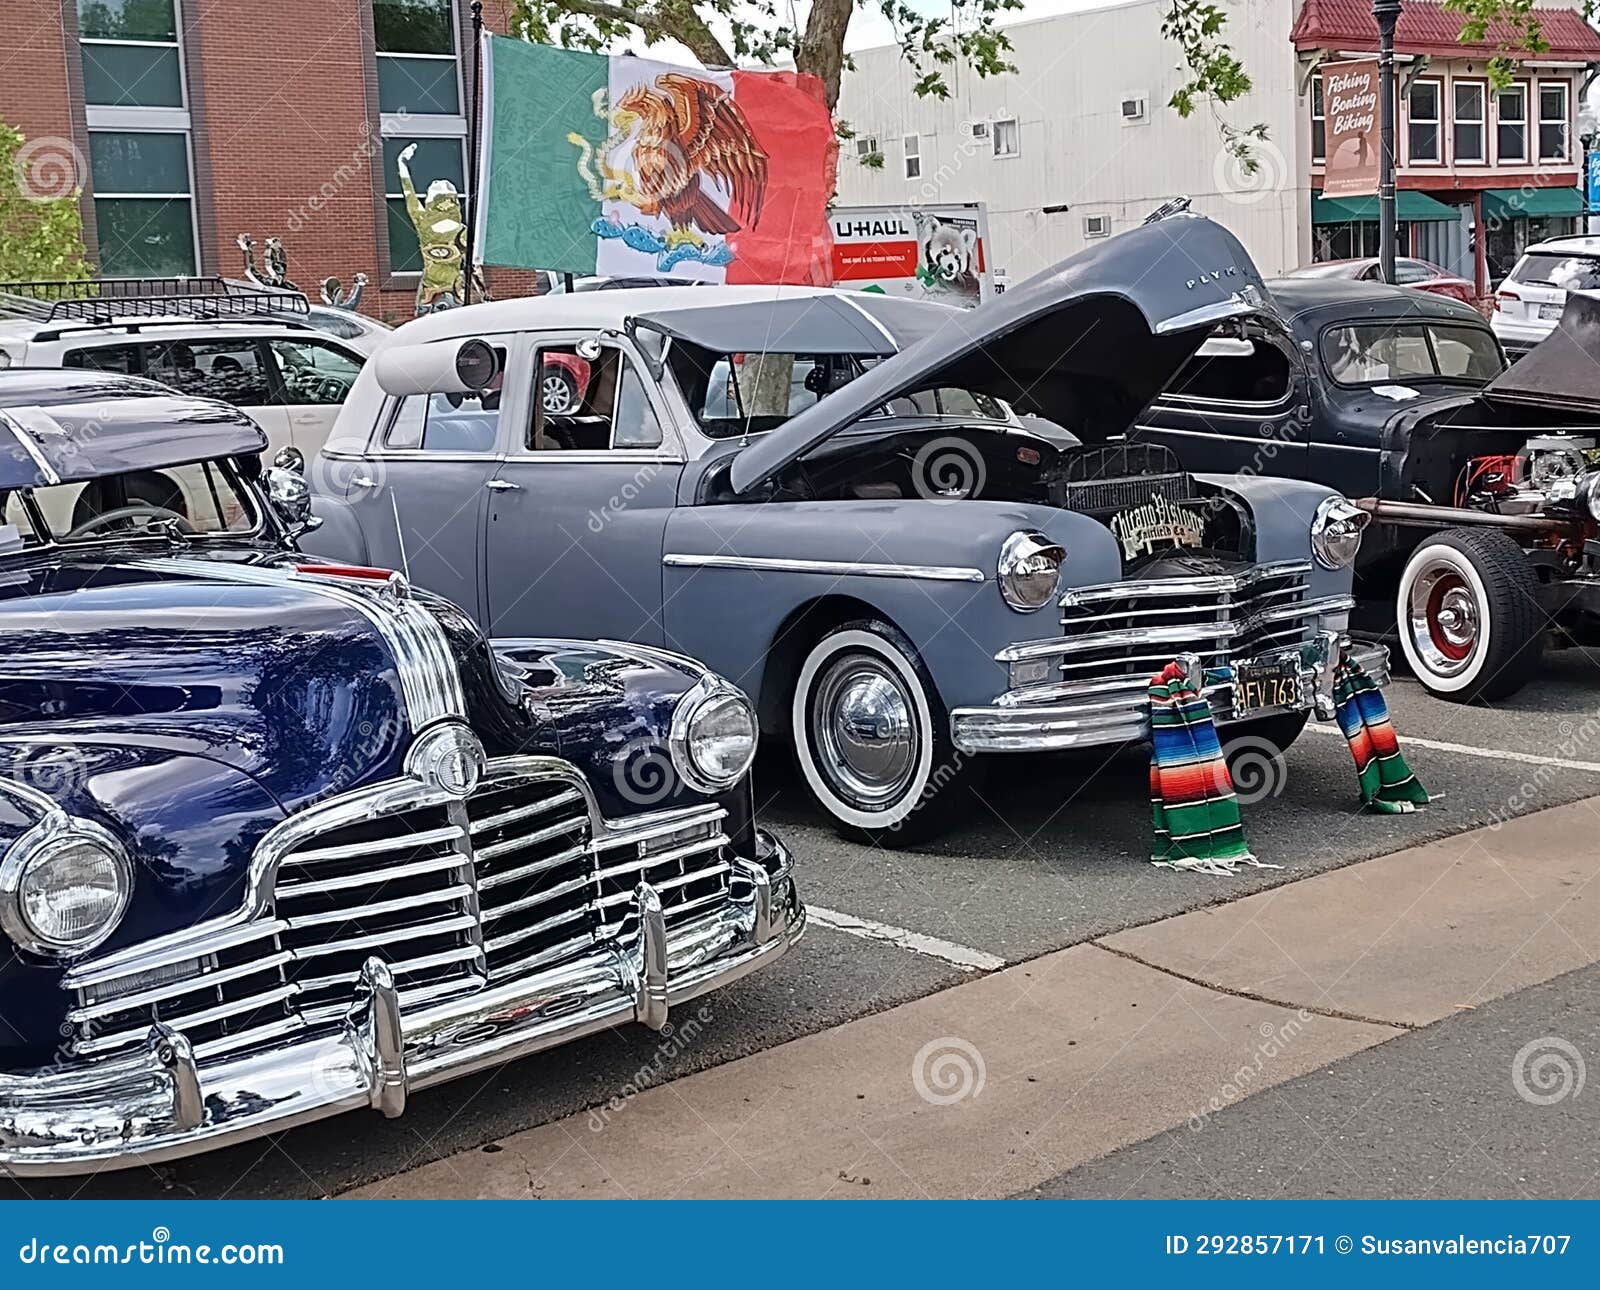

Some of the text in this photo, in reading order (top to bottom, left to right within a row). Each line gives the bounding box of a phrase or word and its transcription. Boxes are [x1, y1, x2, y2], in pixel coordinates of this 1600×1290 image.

[1327, 72, 1370, 96] Fishing
[1331, 93, 1376, 115] Boating
[1334, 114, 1374, 135] Biking
[836, 220, 909, 237] U-HAUL
[1237, 677, 1296, 708] AFV 763
